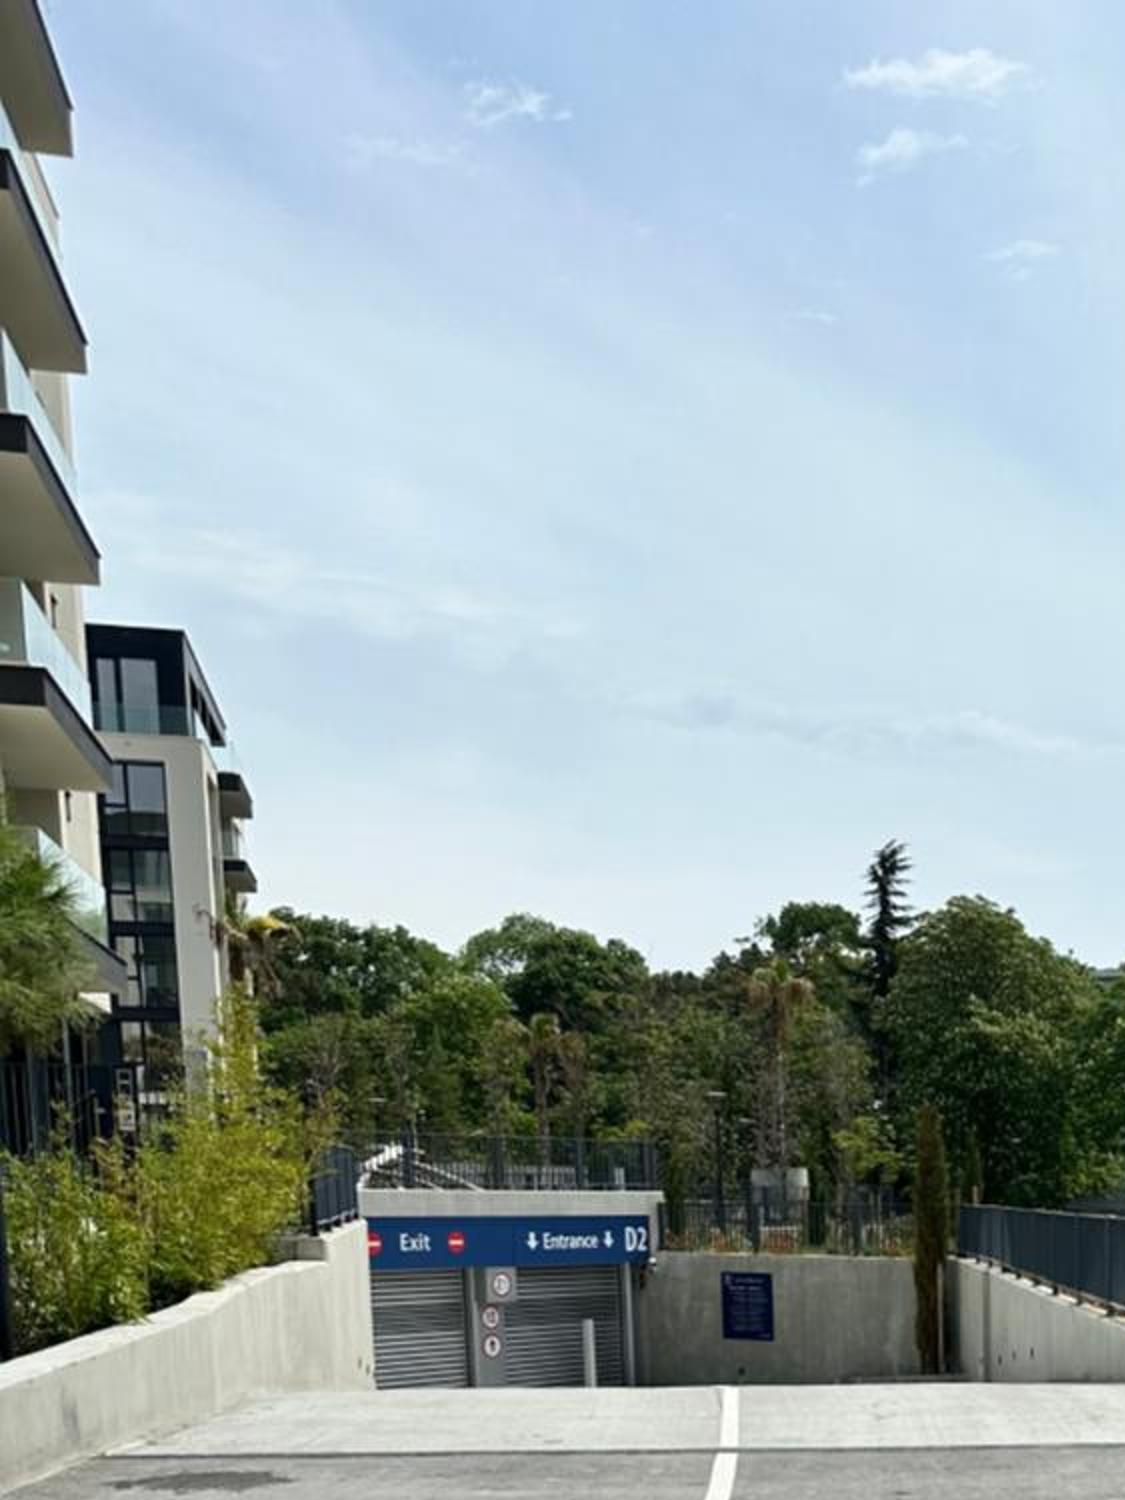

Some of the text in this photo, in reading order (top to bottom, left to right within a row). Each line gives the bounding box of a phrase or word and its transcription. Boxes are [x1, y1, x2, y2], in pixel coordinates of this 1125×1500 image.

[399, 1232, 432, 1252] Exit
[543, 1231, 599, 1250] Entrance
[624, 1226, 648, 1252] D2
